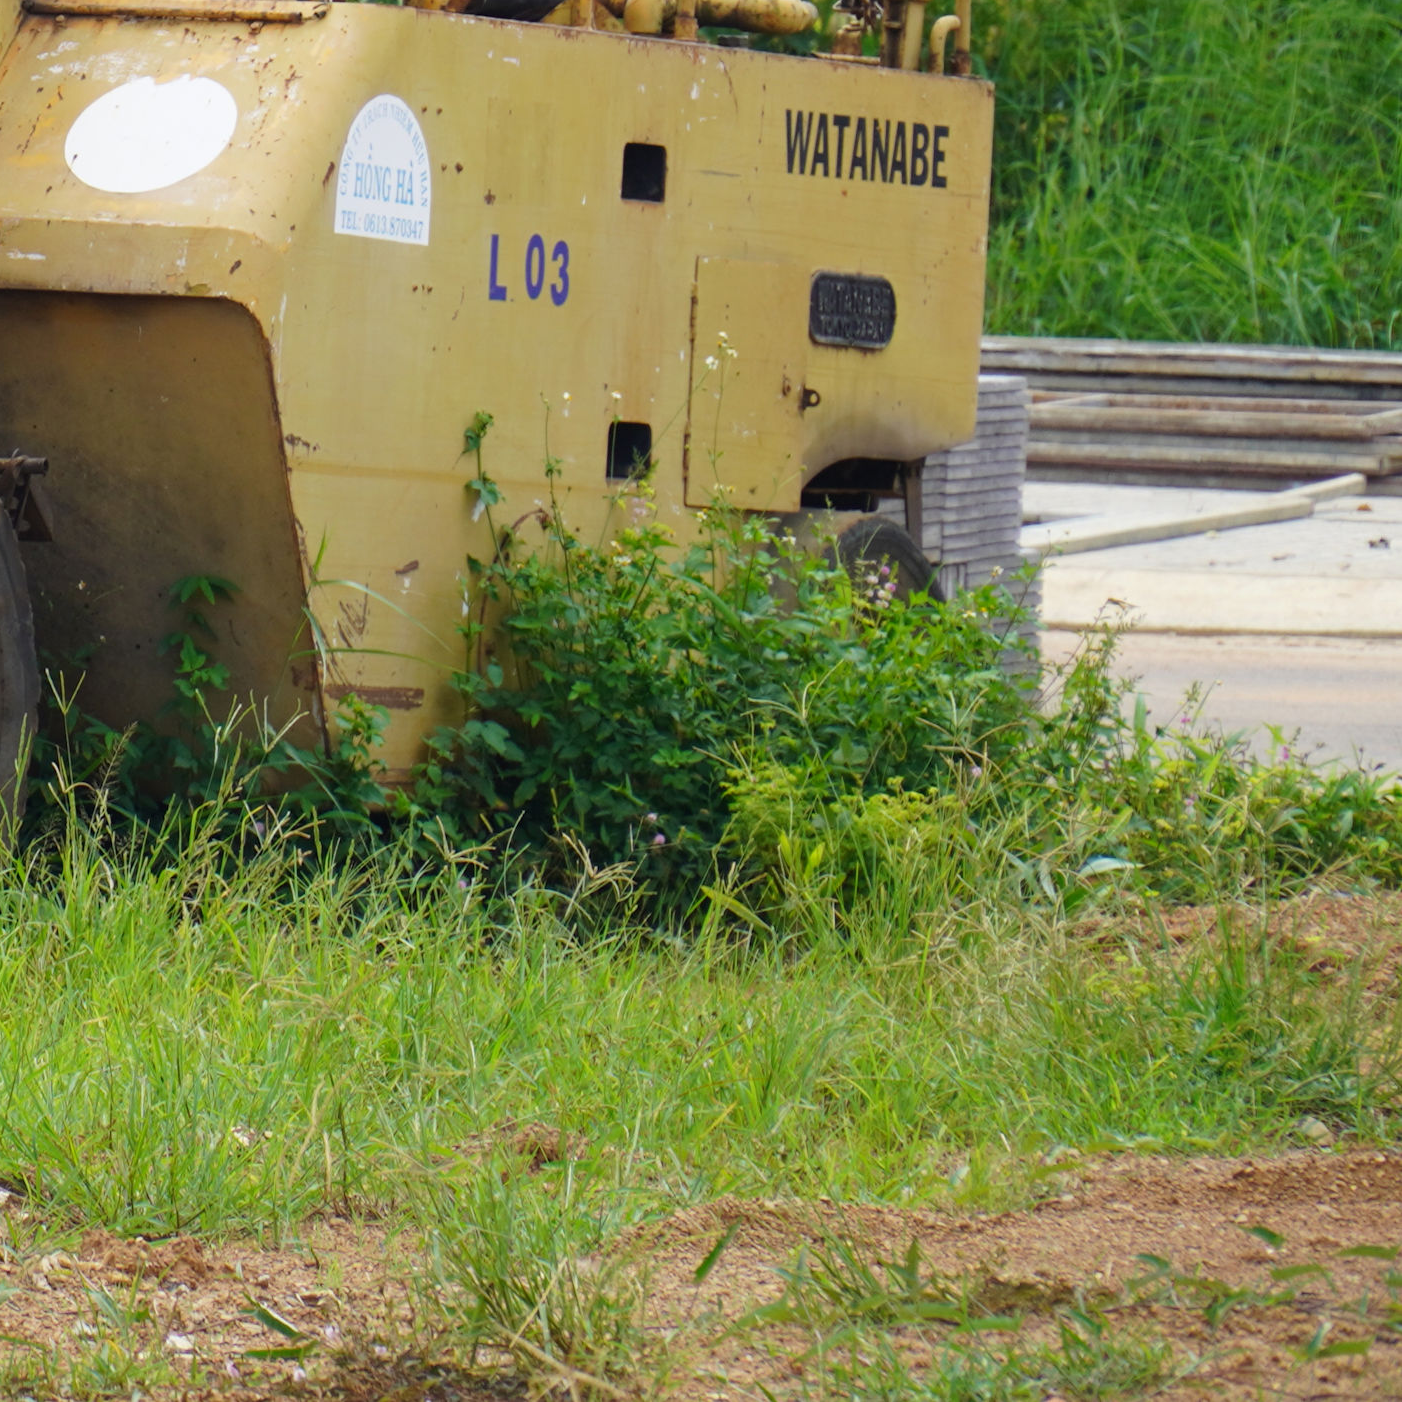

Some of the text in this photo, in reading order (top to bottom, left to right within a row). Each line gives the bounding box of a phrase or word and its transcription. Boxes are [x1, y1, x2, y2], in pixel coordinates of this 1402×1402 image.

[785, 109, 950, 188] WATANABE
[341, 210, 425, 240] TEL: 0613.870347
[525, 233, 570, 307] 03
